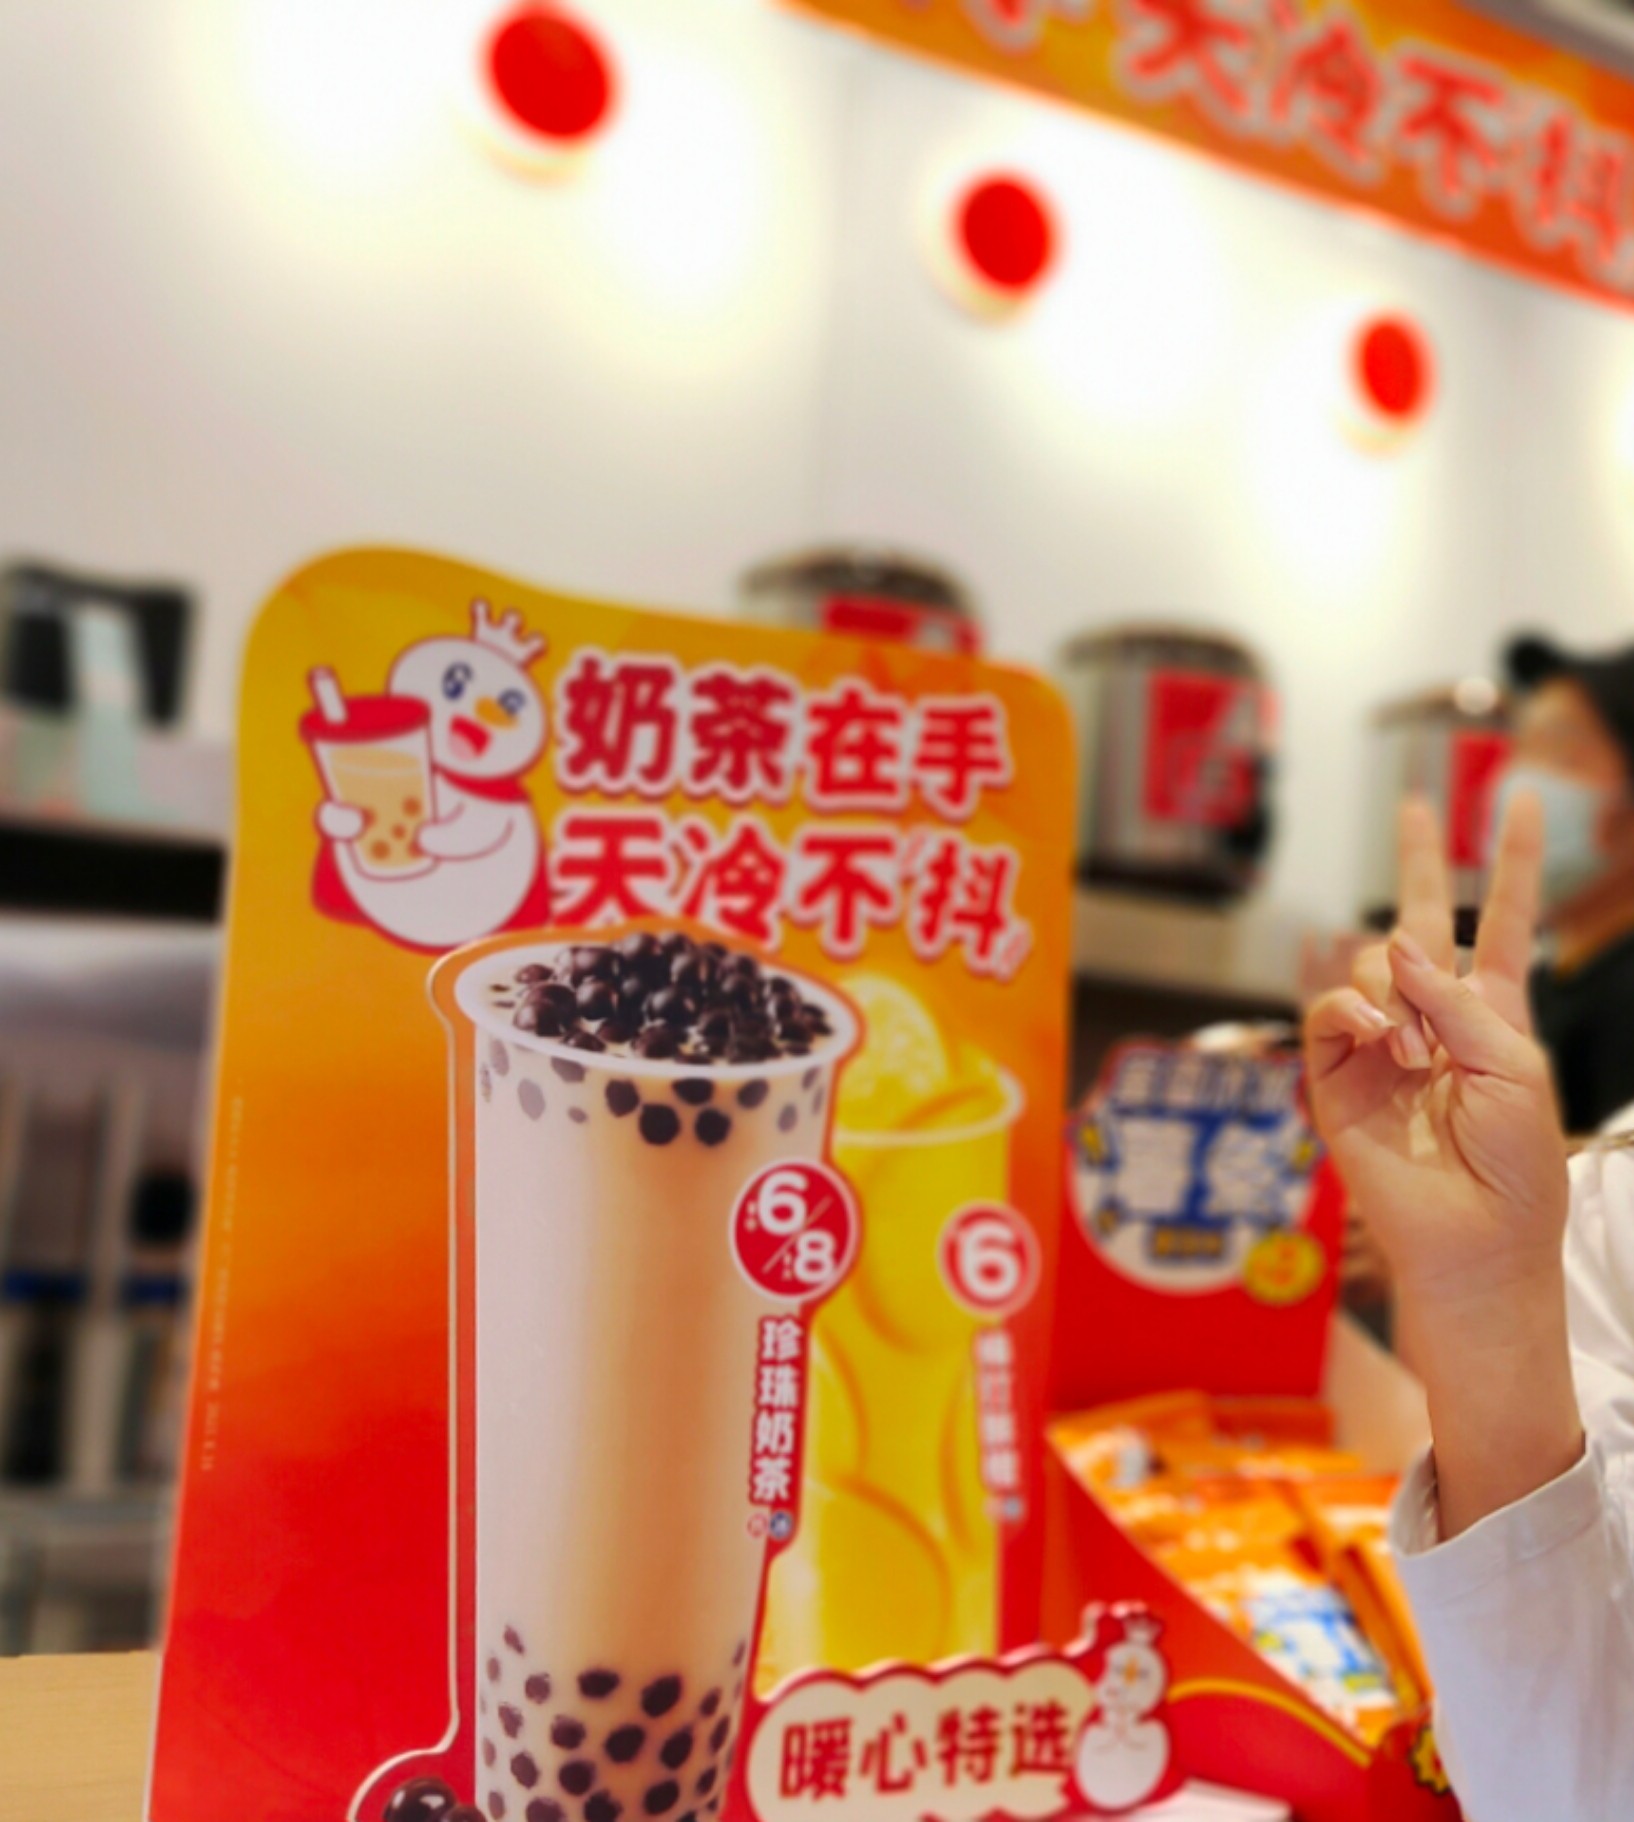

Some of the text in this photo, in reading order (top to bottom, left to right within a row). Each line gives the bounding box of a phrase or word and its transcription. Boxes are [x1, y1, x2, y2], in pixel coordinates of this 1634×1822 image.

[560, 652, 1008, 810] 奶茶在手
[553, 812, 1022, 968] 天冷不抖
[956, 1221, 1021, 1301] 6
[752, 1318, 802, 1502] 珍珠奶茶
[779, 1699, 1074, 1802] 暖心特选
